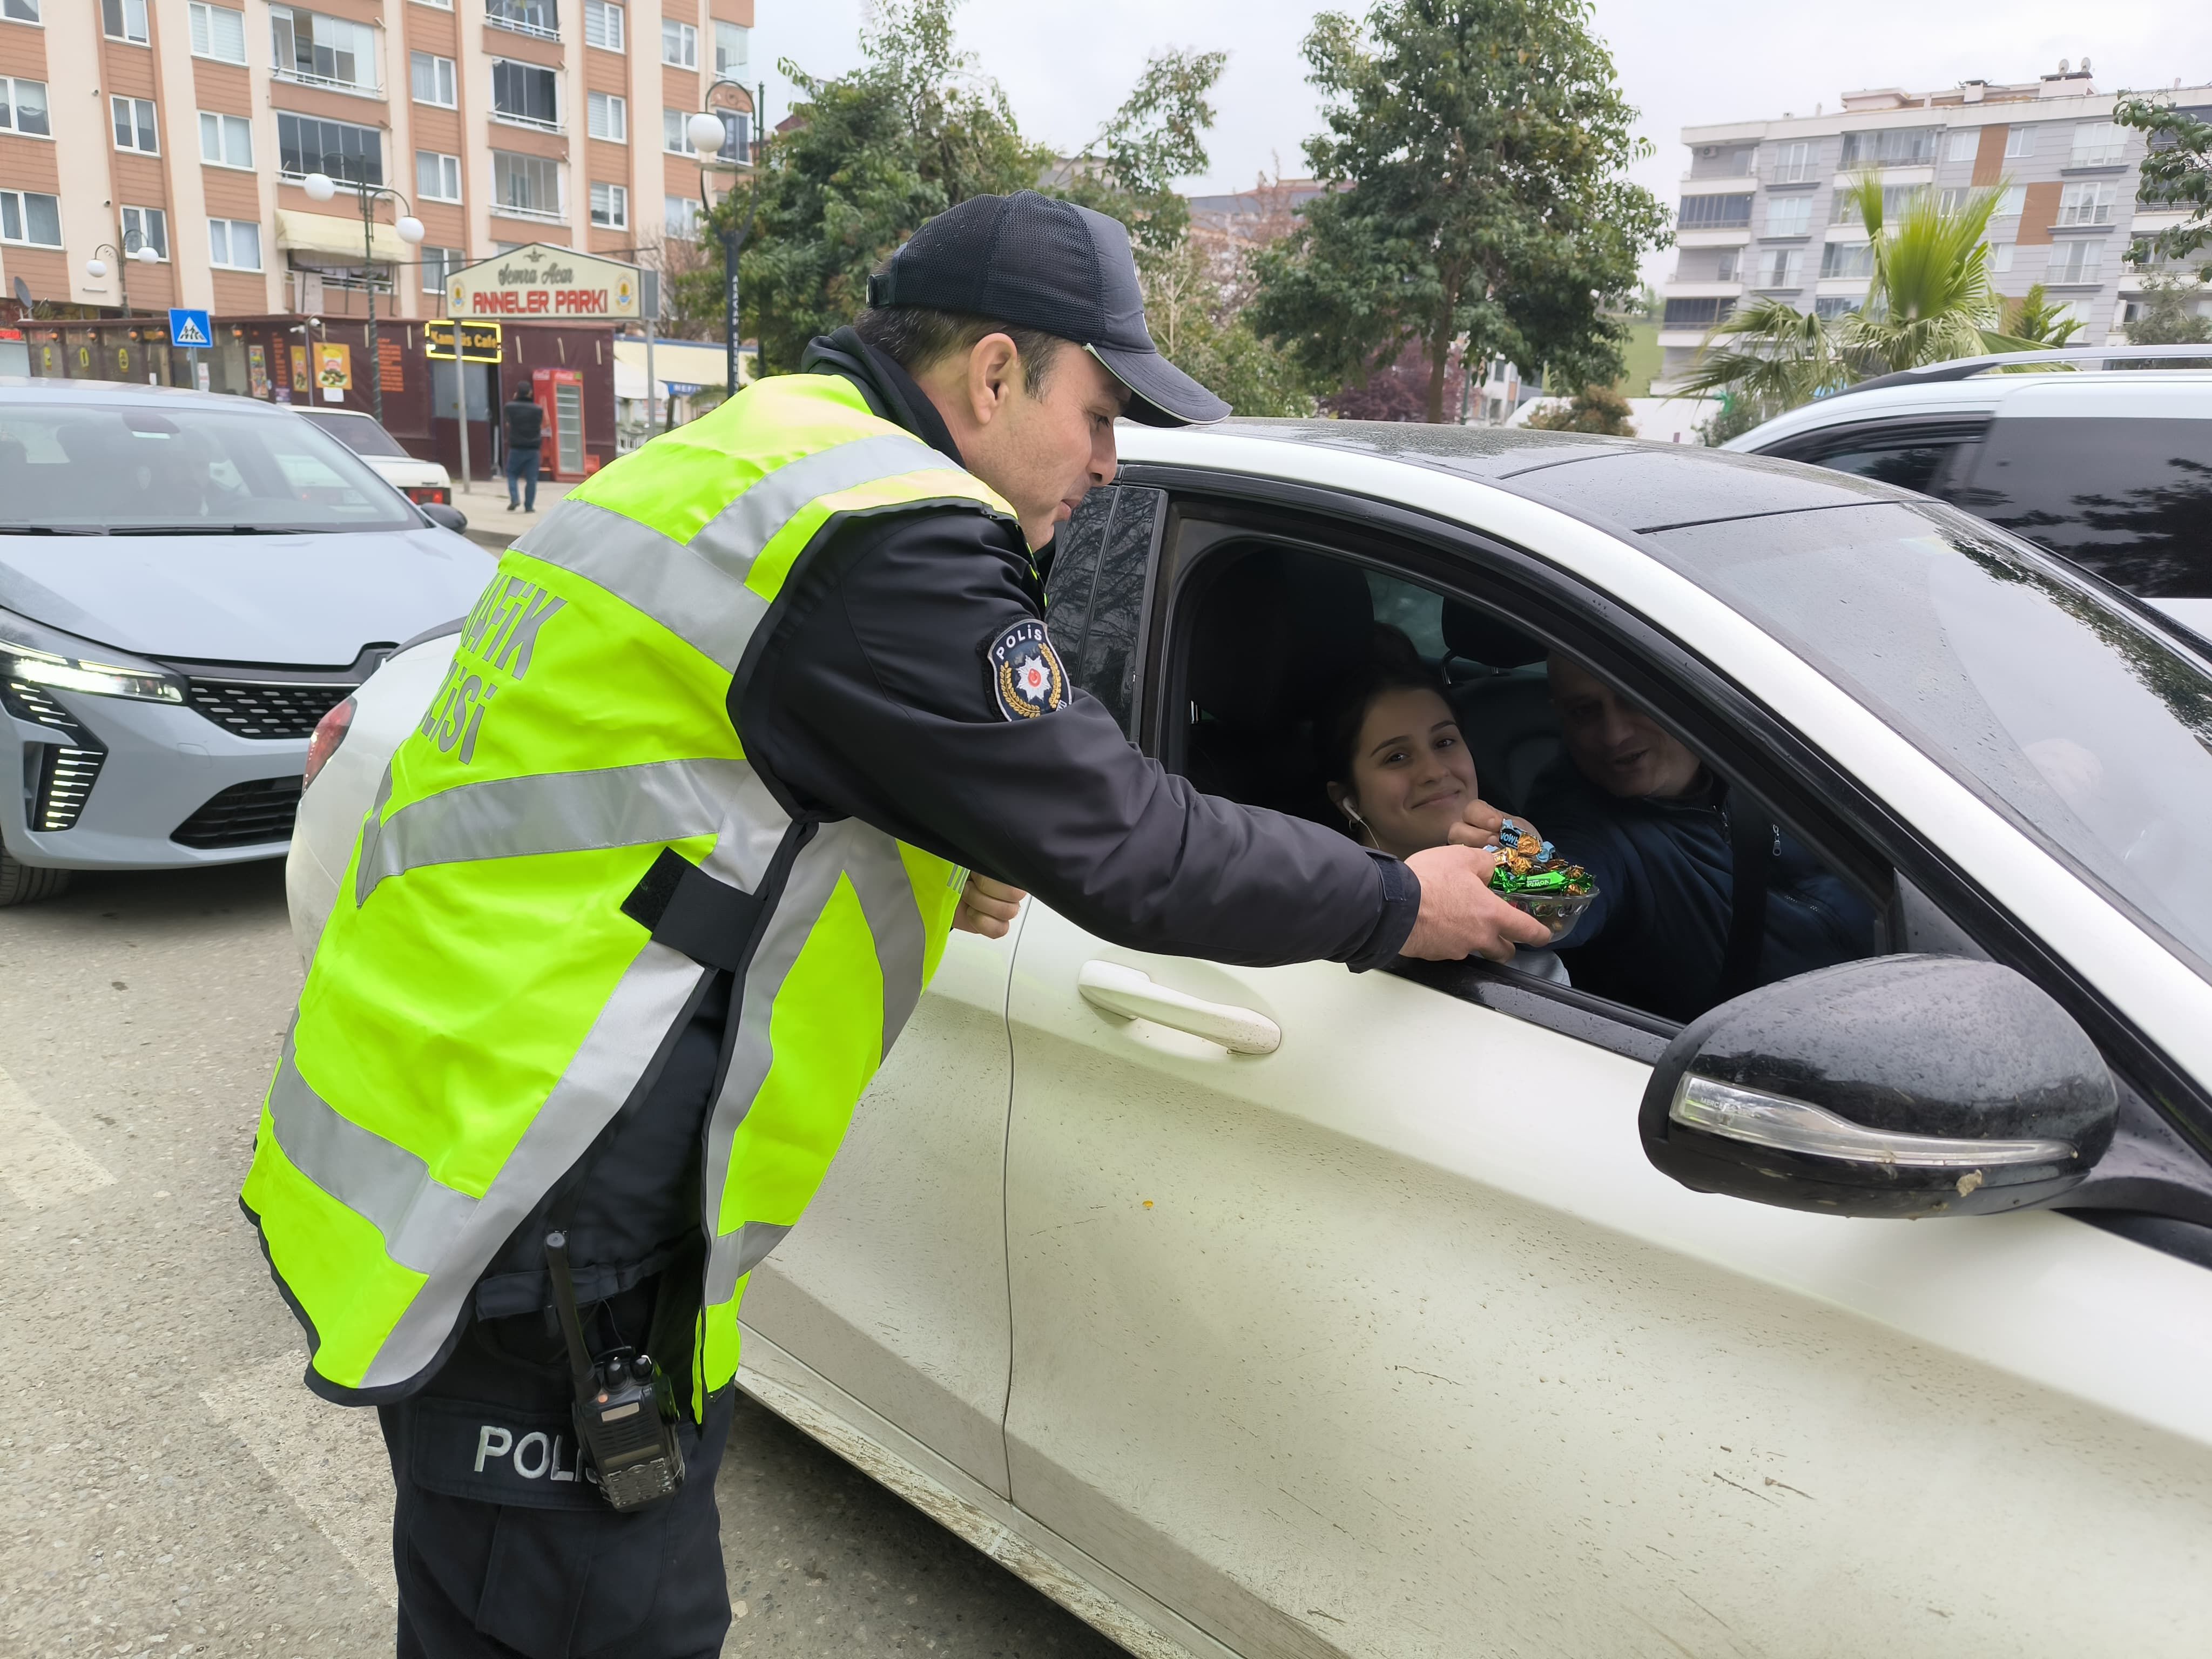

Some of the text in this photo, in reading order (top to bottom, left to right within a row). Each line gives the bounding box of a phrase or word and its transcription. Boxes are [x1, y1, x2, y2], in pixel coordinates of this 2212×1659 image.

[473, 290, 549, 314] ANNELER
[555, 289, 608, 314] PARKI
[430, 331, 497, 348] Kamüs Cafe
[461, 572, 568, 680] RAFİK
[996, 624, 1043, 660] POLİS
